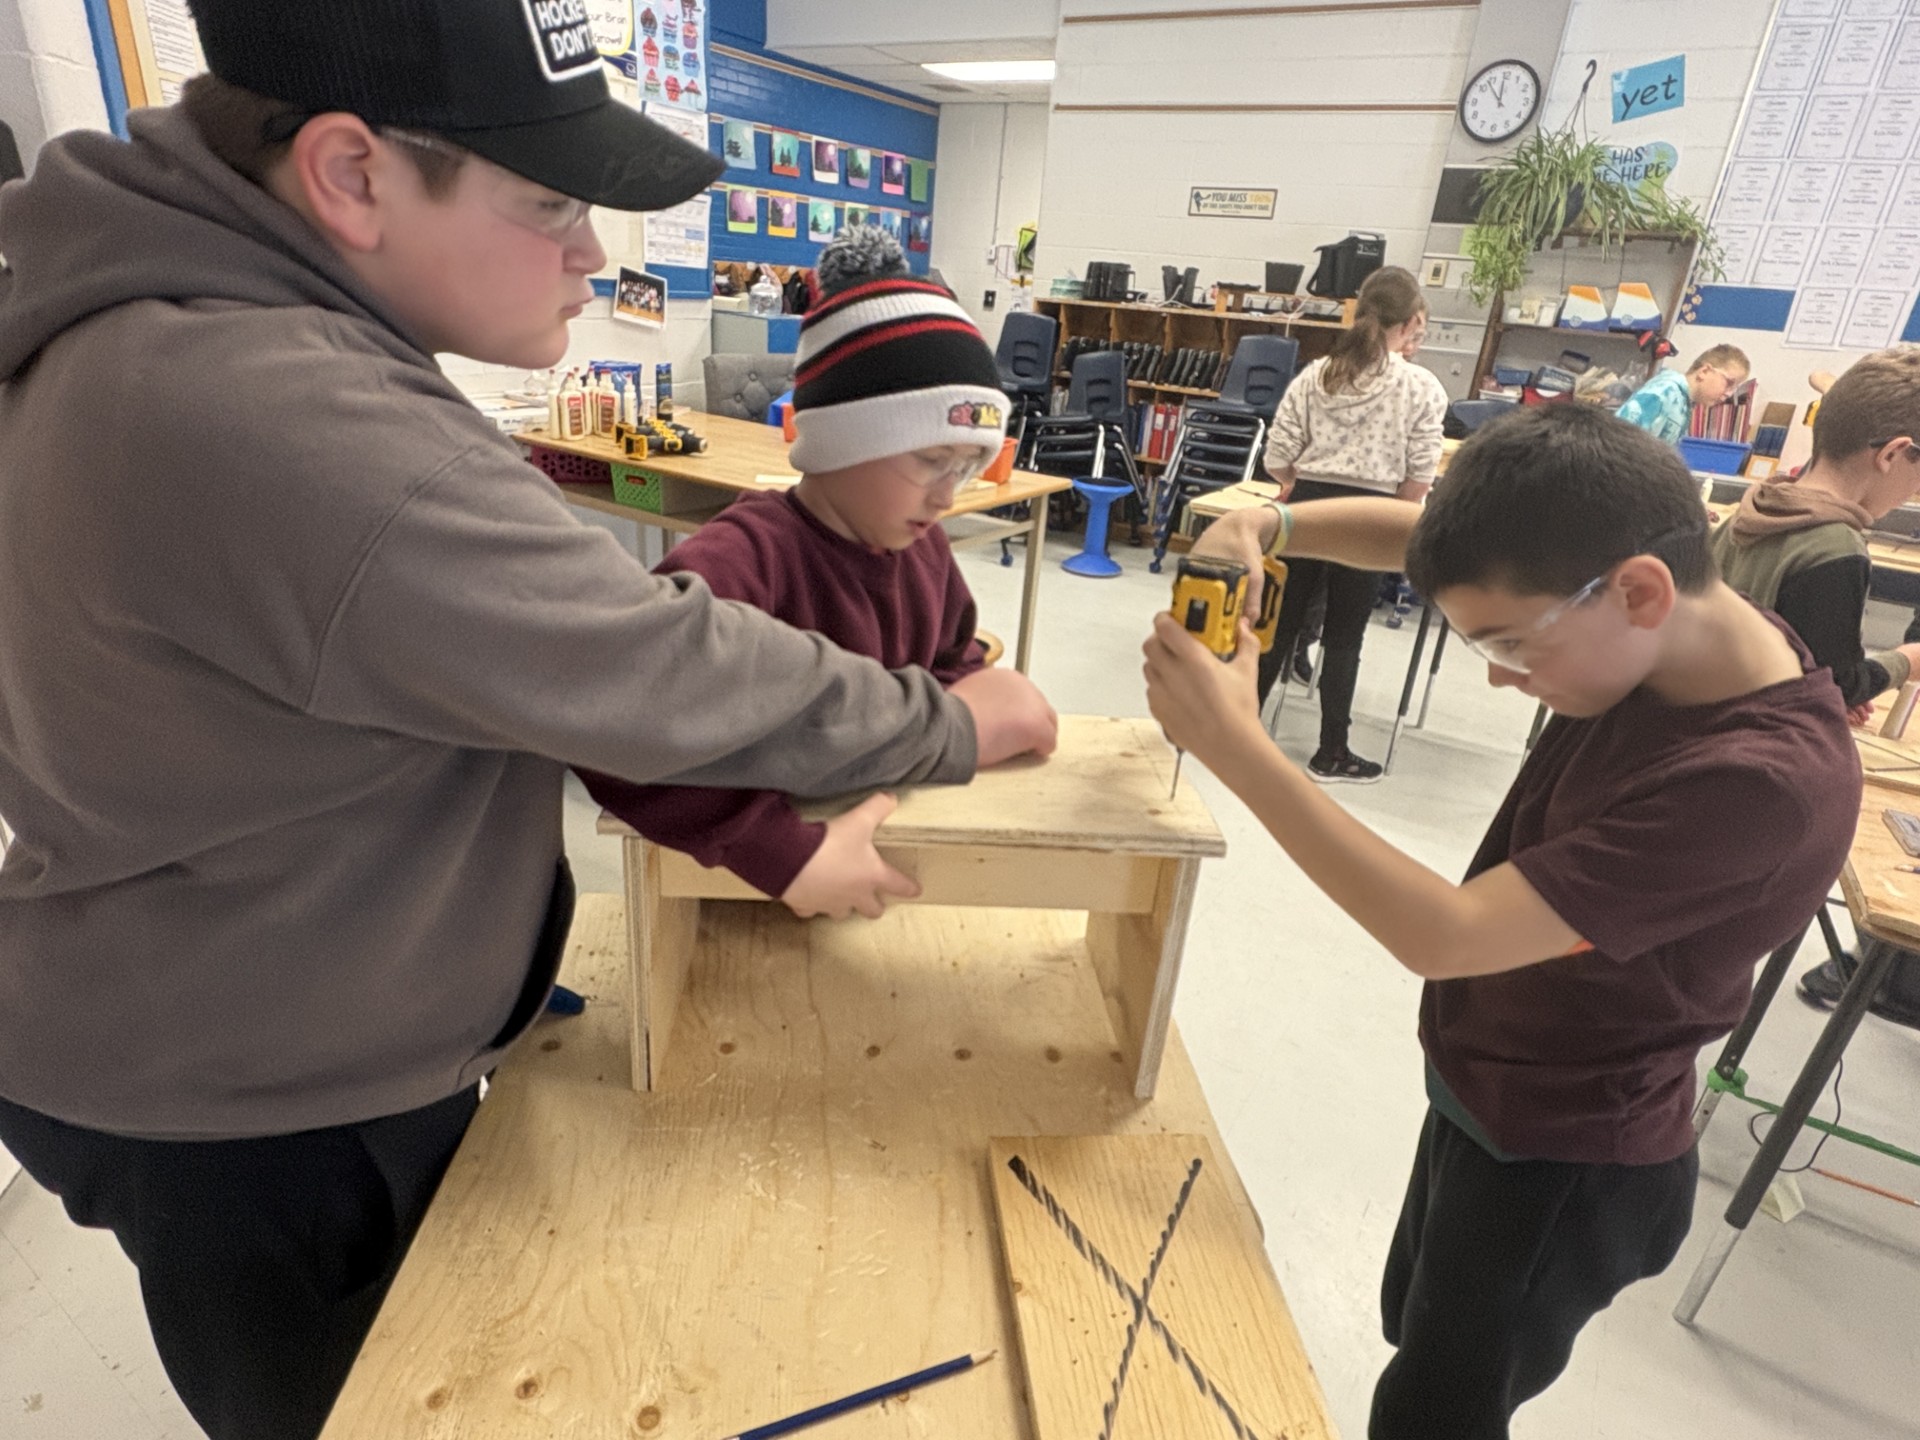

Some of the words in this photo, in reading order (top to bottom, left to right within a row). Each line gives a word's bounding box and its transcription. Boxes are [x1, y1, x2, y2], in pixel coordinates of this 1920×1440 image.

[535, 0, 585, 29] HOCKE
[1502, 70, 1511, 80] 12
[1521, 83, 1529, 93] 2
[1471, 97, 1478, 107] 9
[1522, 97, 1529, 107] 3
[1621, 73, 1678, 121] yet
[1471, 110, 1478, 120] 8
[1515, 110, 1522, 119] 4
[1480, 120, 1486, 128] 7
[1490, 123, 1497, 133] 6
[1503, 120, 1510, 129] 5
[1612, 146, 1645, 166] HAS
[1211, 192, 1228, 202] YOU
[1228, 193, 1248, 203] MISS
